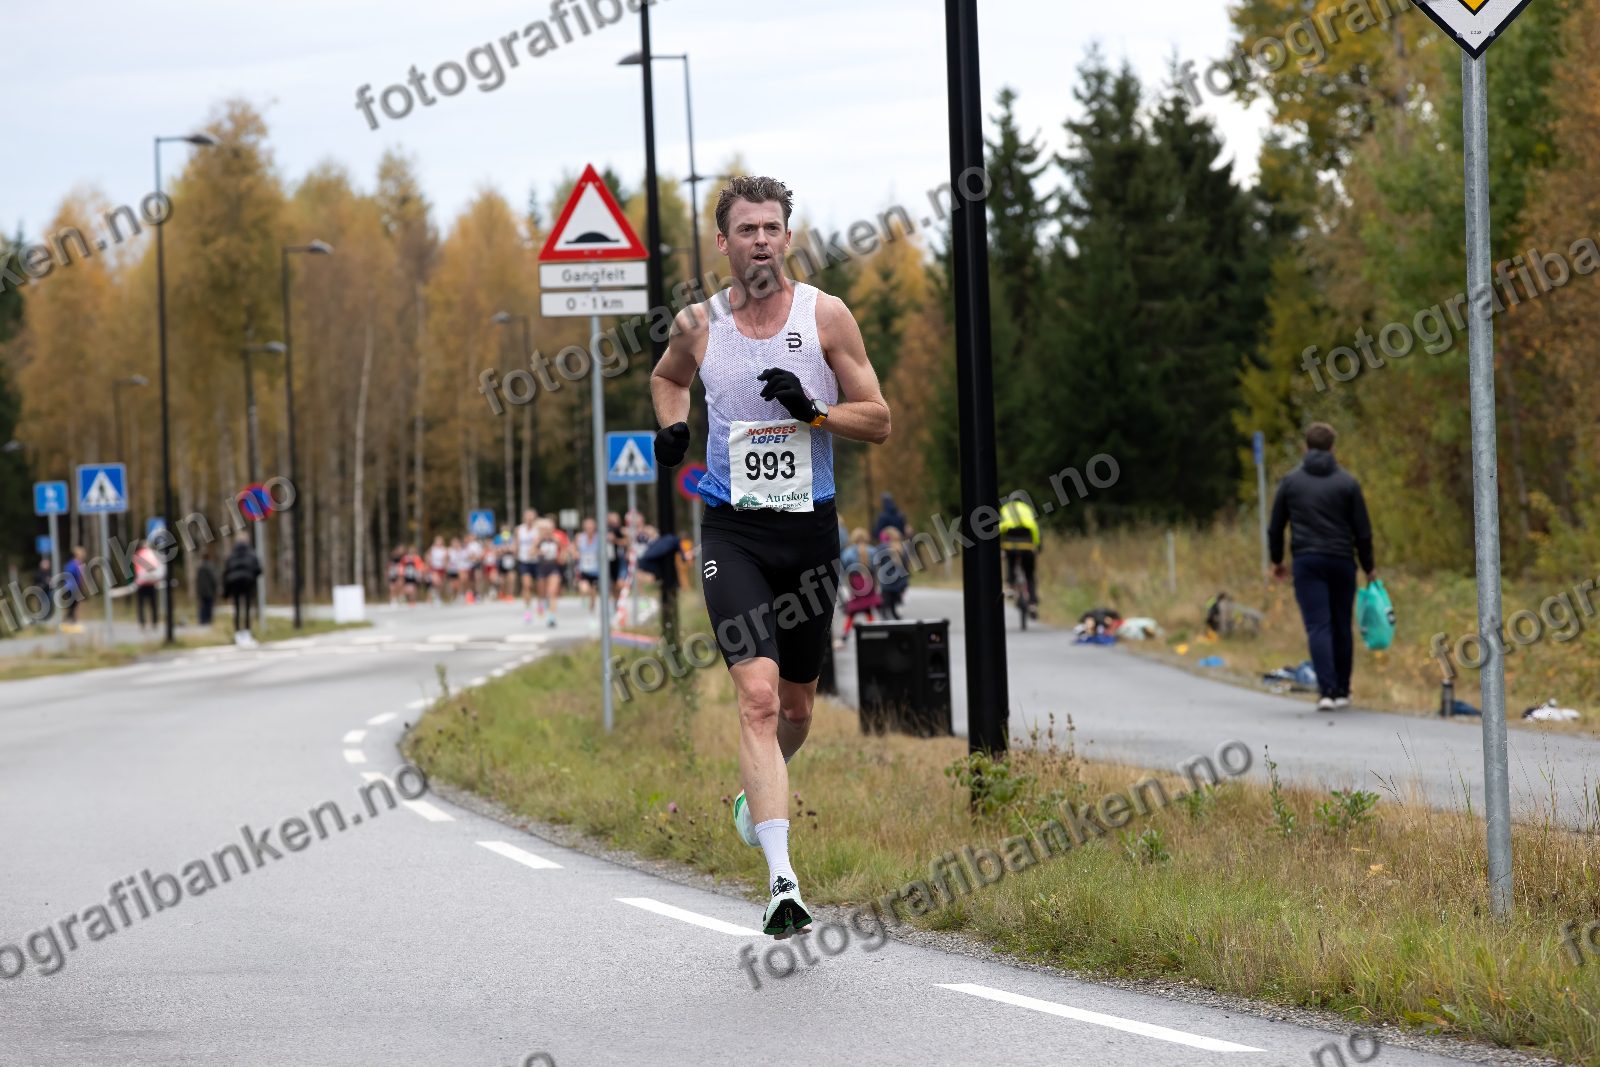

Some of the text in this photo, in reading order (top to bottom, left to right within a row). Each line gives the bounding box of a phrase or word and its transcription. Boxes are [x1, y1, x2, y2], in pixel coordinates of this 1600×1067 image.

[561, 268, 625, 283] Gangfelt
[746, 425, 797, 436] NORGES
[751, 434, 788, 445] LØPET
[745, 450, 796, 480] 993
[765, 491, 809, 503] Aurskog
